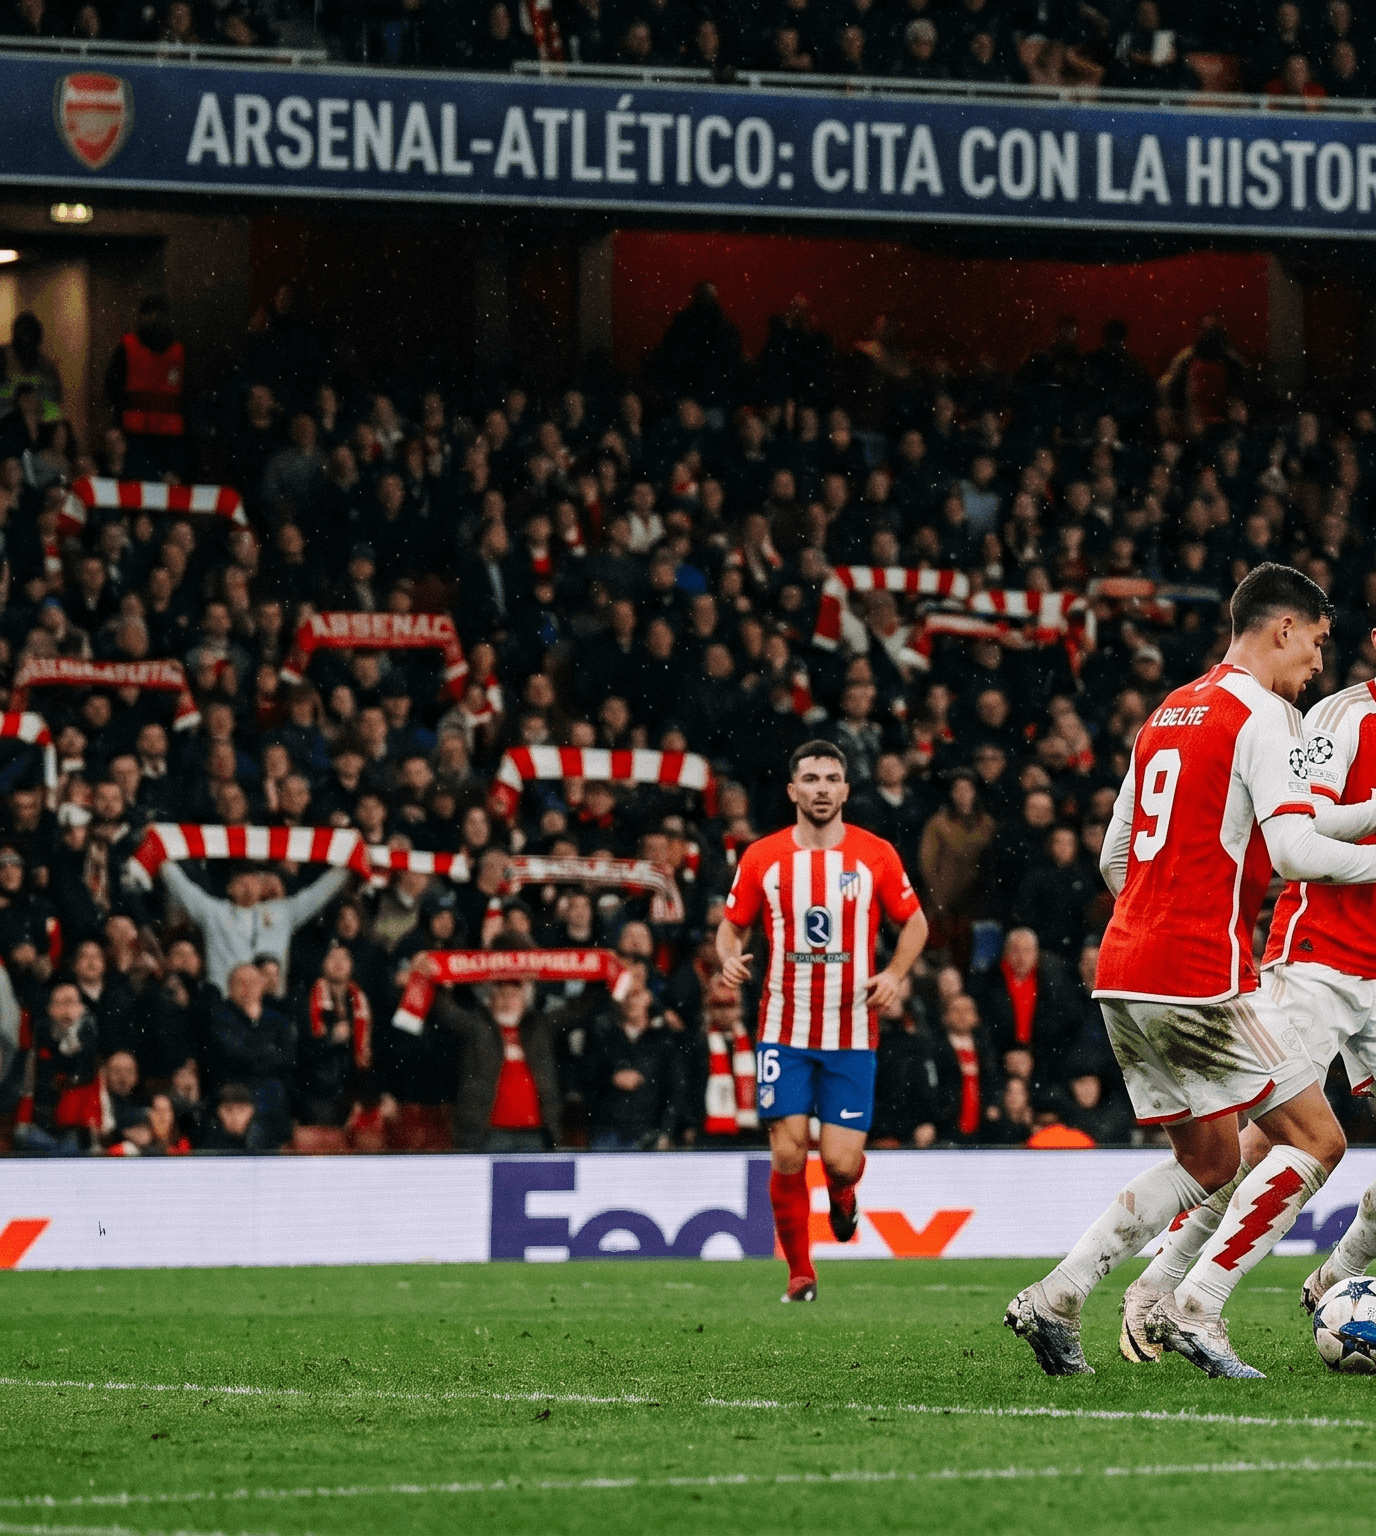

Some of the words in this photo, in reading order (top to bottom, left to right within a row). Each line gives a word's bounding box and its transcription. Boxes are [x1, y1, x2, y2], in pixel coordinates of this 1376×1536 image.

[187, 92, 795, 189] ARSENAL-ATLÉTICO:
[811, 120, 944, 195] CITA
[959, 126, 1078, 200] CON
[1097, 133, 1171, 204] LA
[1133, 747, 1182, 862] 9
[757, 1048, 781, 1083] 16
